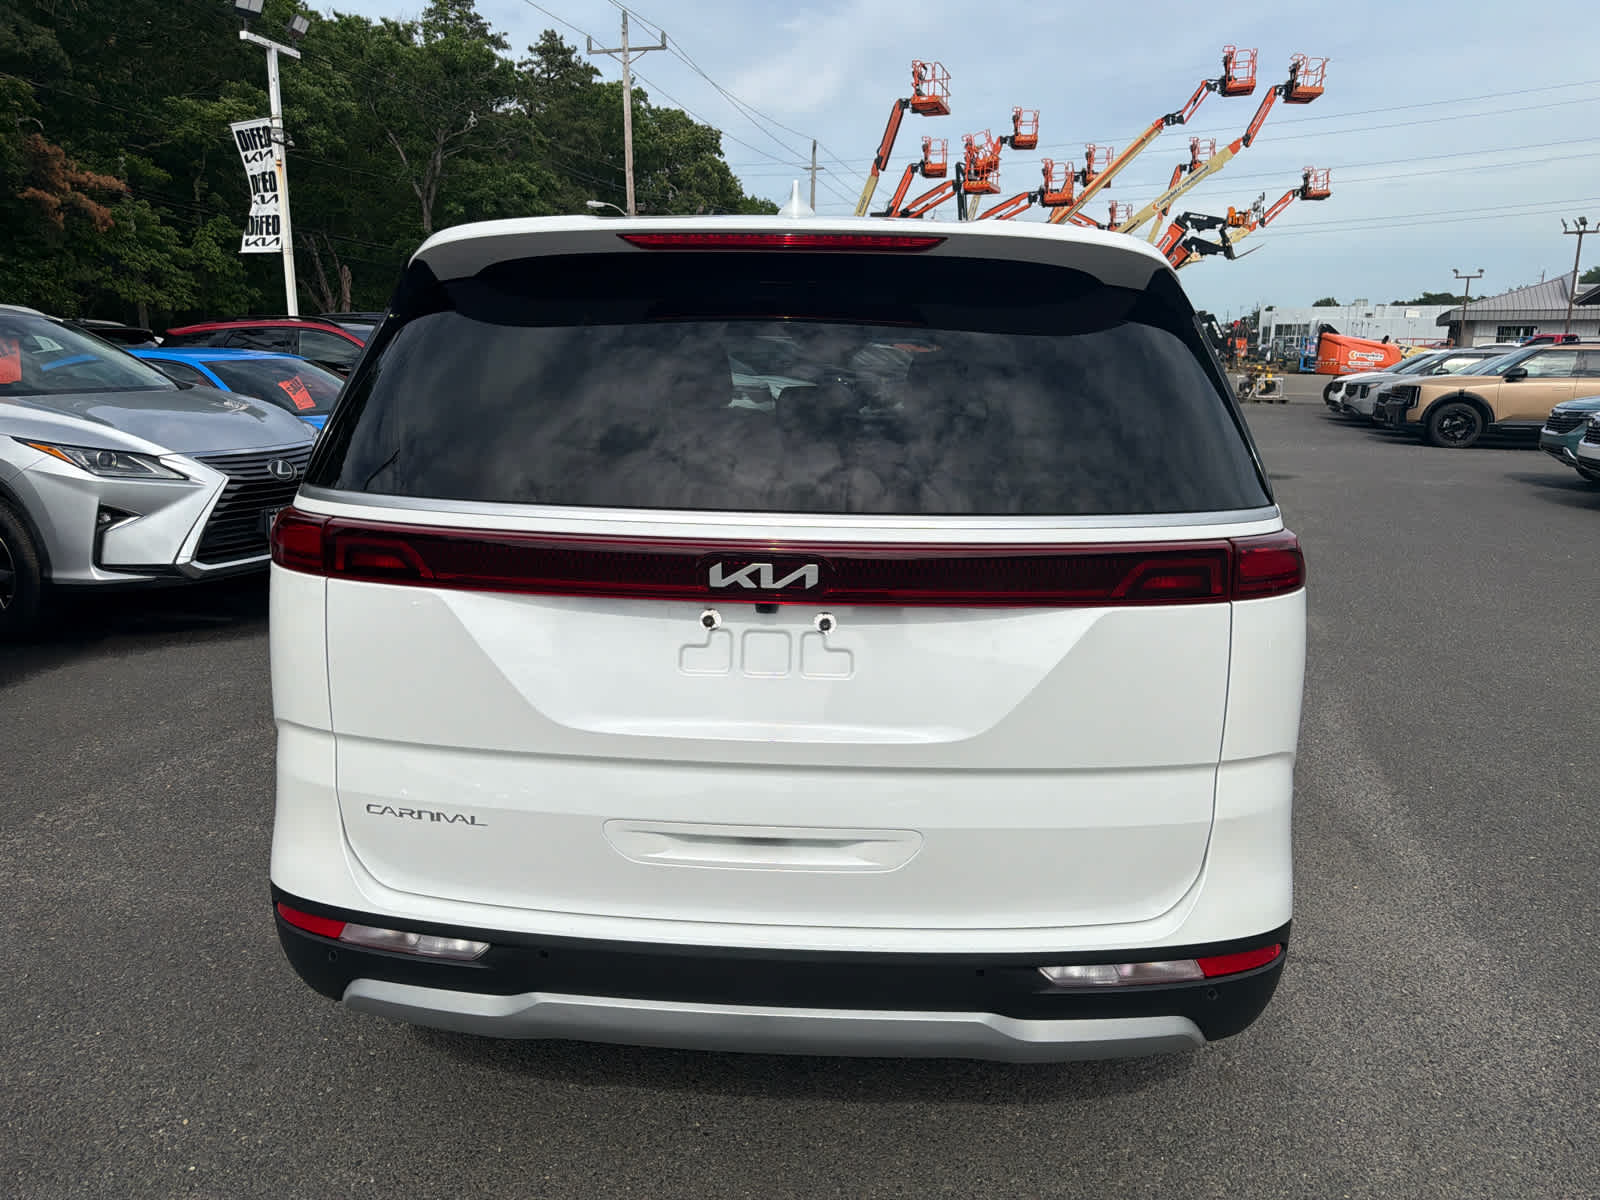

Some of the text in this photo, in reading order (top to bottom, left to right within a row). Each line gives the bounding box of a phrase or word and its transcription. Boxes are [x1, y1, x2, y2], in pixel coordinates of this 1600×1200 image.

[250, 171, 277, 195] DiEO
[245, 236, 281, 247] KIA
[709, 562, 819, 589] KIA
[366, 803, 489, 827] CARNIVAL
